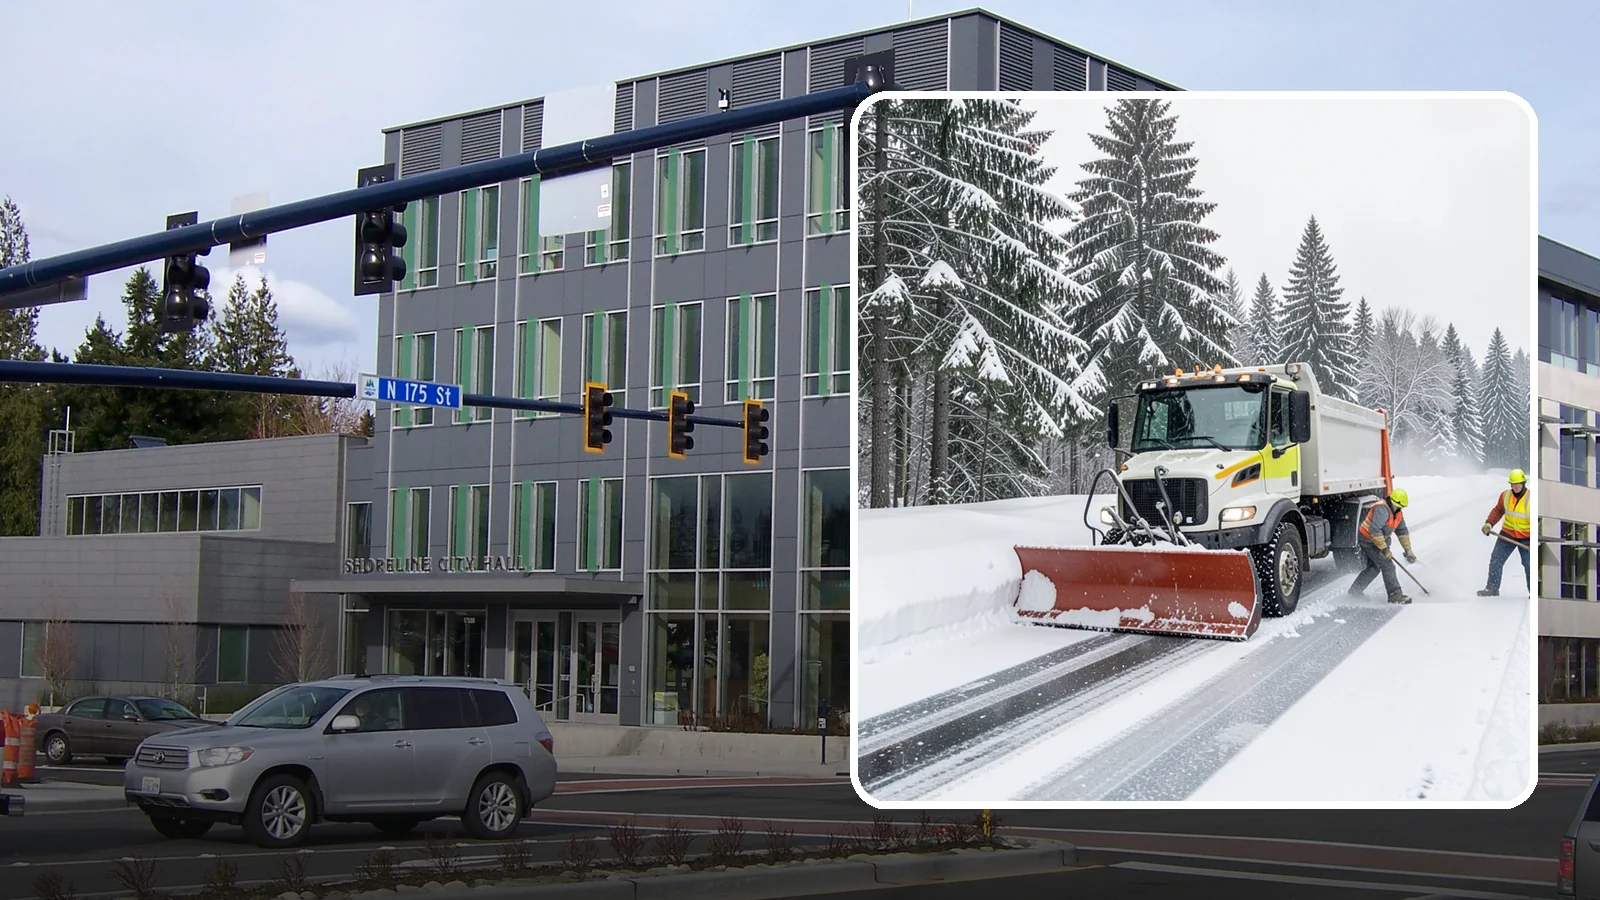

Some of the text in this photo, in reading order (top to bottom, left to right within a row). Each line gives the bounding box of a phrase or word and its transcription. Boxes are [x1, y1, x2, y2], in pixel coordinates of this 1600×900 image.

[387, 380, 451, 406] N 175 St
[344, 555, 526, 574] SHORELINE CITY HALL
